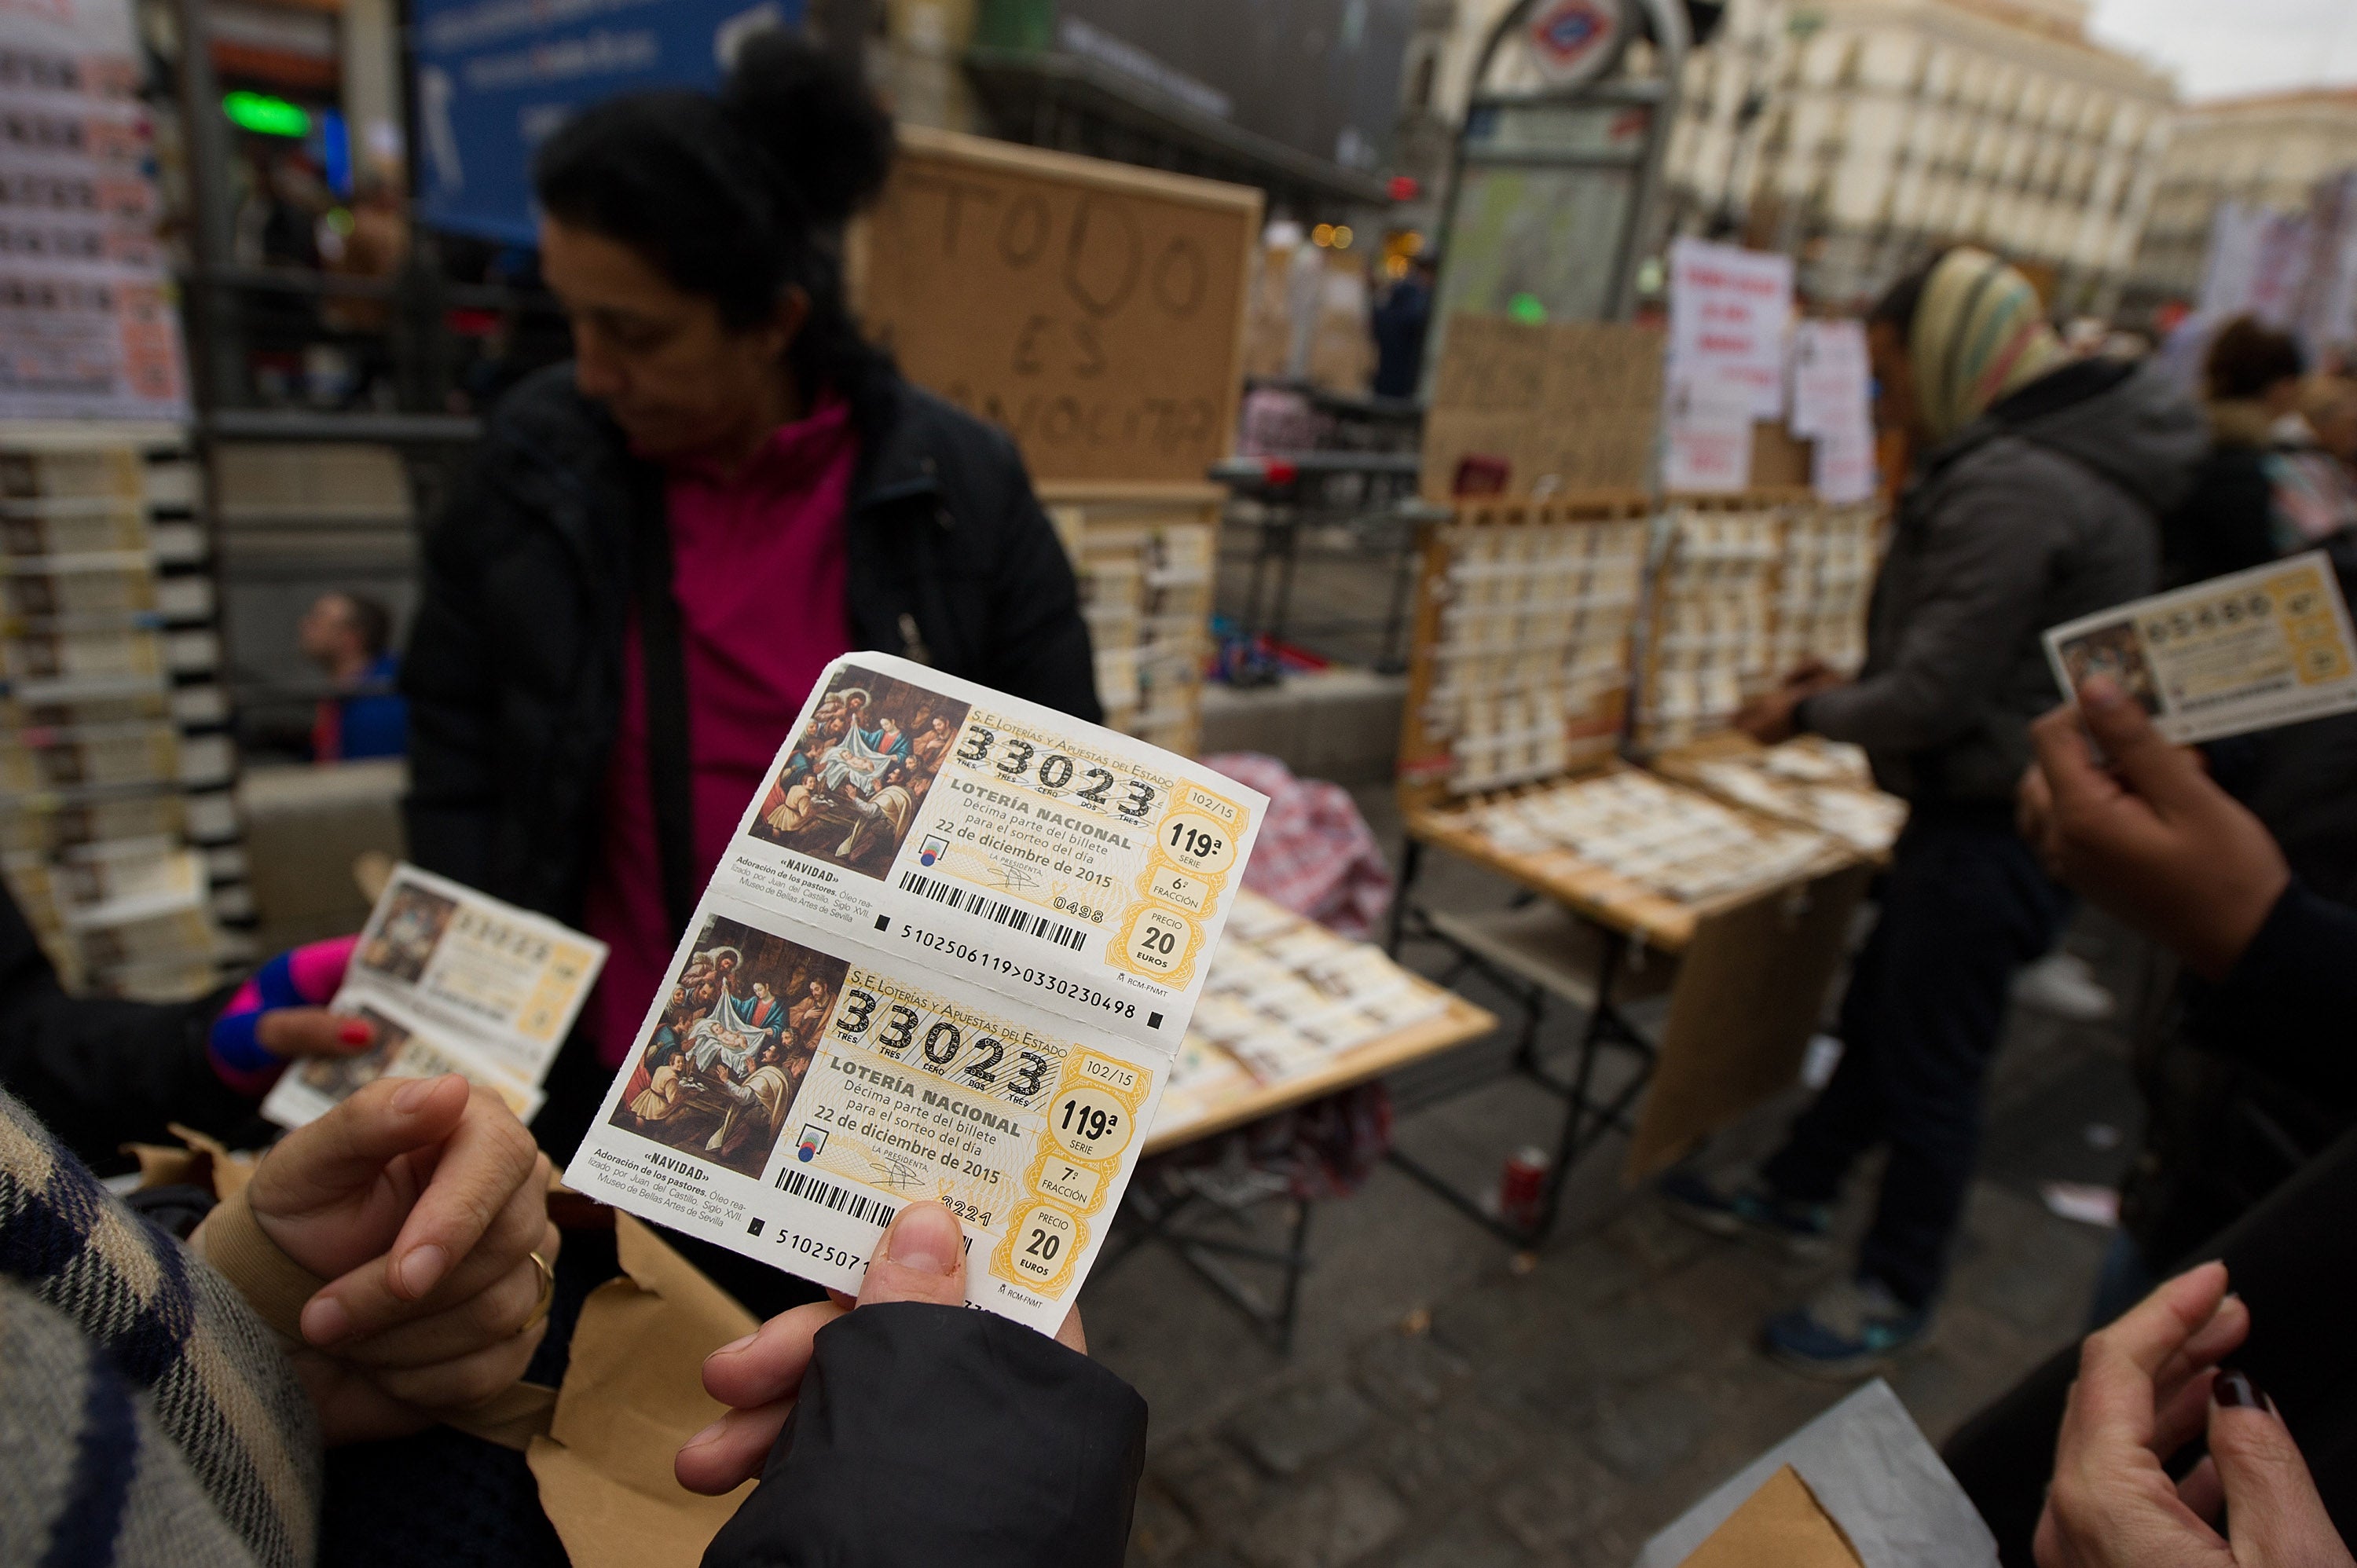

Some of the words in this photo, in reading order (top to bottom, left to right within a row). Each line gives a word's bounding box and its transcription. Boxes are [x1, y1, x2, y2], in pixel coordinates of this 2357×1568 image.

[956, 725, 1155, 818] 33023
[957, 757, 976, 769] TRES
[997, 771, 1017, 783] TRES
[1037, 786, 1058, 798] CERO
[1080, 800, 1098, 811] DOS
[1119, 814, 1139, 826] TRES
[950, 778, 1029, 815] LOTERÍA
[1036, 808, 1131, 850] NACIONAL
[962, 797, 1007, 819] Décima
[1009, 815, 1043, 833] parte
[1046, 827, 1067, 840] del
[1069, 833, 1108, 855] billete
[1193, 792, 1233, 819] 102/15
[935, 819, 955, 833] 22
[957, 826, 976, 841] de
[979, 834, 1050, 866] diciembre
[1054, 859, 1072, 874] de
[1075, 866, 1113, 888] 2015
[965, 815, 993, 829] para
[996, 824, 1009, 834] el
[1010, 830, 1049, 848] sorteo
[1052, 843, 1072, 856] del
[1075, 851, 1094, 864] día
[1178, 854, 1201, 869] SERIE
[731, 863, 751, 877] lizado
[752, 873, 767, 881] por
[768, 877, 786, 888] Juan
[788, 885, 801, 893] del
[833, 899, 851, 911] Siglo
[736, 856, 776, 875] Adoración
[777, 870, 788, 879] de
[788, 874, 801, 884] los
[801, 880, 837, 896] pastores.
[858, 899, 873, 908] rea-
[739, 876, 765, 892] Museo
[764, 886, 775, 896] de
[775, 889, 798, 903] Bellas
[797, 897, 819, 910] Artes
[819, 905, 829, 914] de
[829, 908, 853, 923] Sevilla
[1153, 885, 1199, 908] FRACCIÓN
[1053, 896, 1104, 924] 0498
[1151, 913, 1182, 930] PRECIO
[1136, 951, 1168, 968] EUROS
[1141, 926, 1175, 954] 20
[1127, 977, 1168, 997] RCM-FNMT
[832, 989, 1054, 1097] 33023
[837, 1030, 858, 1044] TRES
[878, 1046, 901, 1060] TRES
[922, 1063, 946, 1076] CERO
[966, 1079, 988, 1091] DOS
[1006, 1094, 1031, 1108] TRES
[1087, 1061, 1133, 1086] 102/15
[830, 1056, 915, 1098] LOTERÍA
[921, 1090, 1021, 1138] NACIONAL
[844, 1079, 891, 1105] Décima
[893, 1100, 929, 1119] parte
[933, 1112, 954, 1128] del
[955, 1119, 996, 1145] billete
[814, 1105, 834, 1123] 22
[837, 1114, 857, 1130] de
[861, 1123, 937, 1160] diciembre
[940, 1152, 959, 1170] de
[962, 1160, 1000, 1184] 2015
[845, 1099, 876, 1116] para
[879, 1111, 893, 1122] el
[894, 1117, 936, 1138] sorteo
[939, 1132, 960, 1148] del
[962, 1141, 982, 1156] día
[871, 1145, 881, 1154] LA
[1069, 1139, 1094, 1156] SERIE
[587, 1156, 611, 1172] lizado
[612, 1168, 629, 1178] por
[629, 1174, 650, 1187] Juan
[652, 1182, 669, 1193] del
[669, 1188, 698, 1206] Castillo.
[702, 1200, 722, 1214] Siglo
[724, 1208, 742, 1222] XVII.
[594, 1149, 640, 1171] Adoración
[640, 1166, 652, 1176] de
[653, 1170, 667, 1181] los
[666, 1178, 707, 1197] pastores.
[709, 1189, 729, 1205] Óleo
[730, 1200, 746, 1211] rea-
[597, 1172, 626, 1190] Museo
[626, 1185, 638, 1194] de
[638, 1188, 663, 1204] Bellas
[662, 1198, 686, 1213] Artes
[686, 1207, 698, 1217] de
[698, 1211, 724, 1227] Sevilla
[1042, 1179, 1087, 1203] FRACCIÓN
[1038, 1211, 1069, 1230] PRECIO
[1020, 1258, 1049, 1276] EUROS
[1025, 1229, 1060, 1261] 20
[1006, 1289, 1043, 1309] RCM-FNMT
